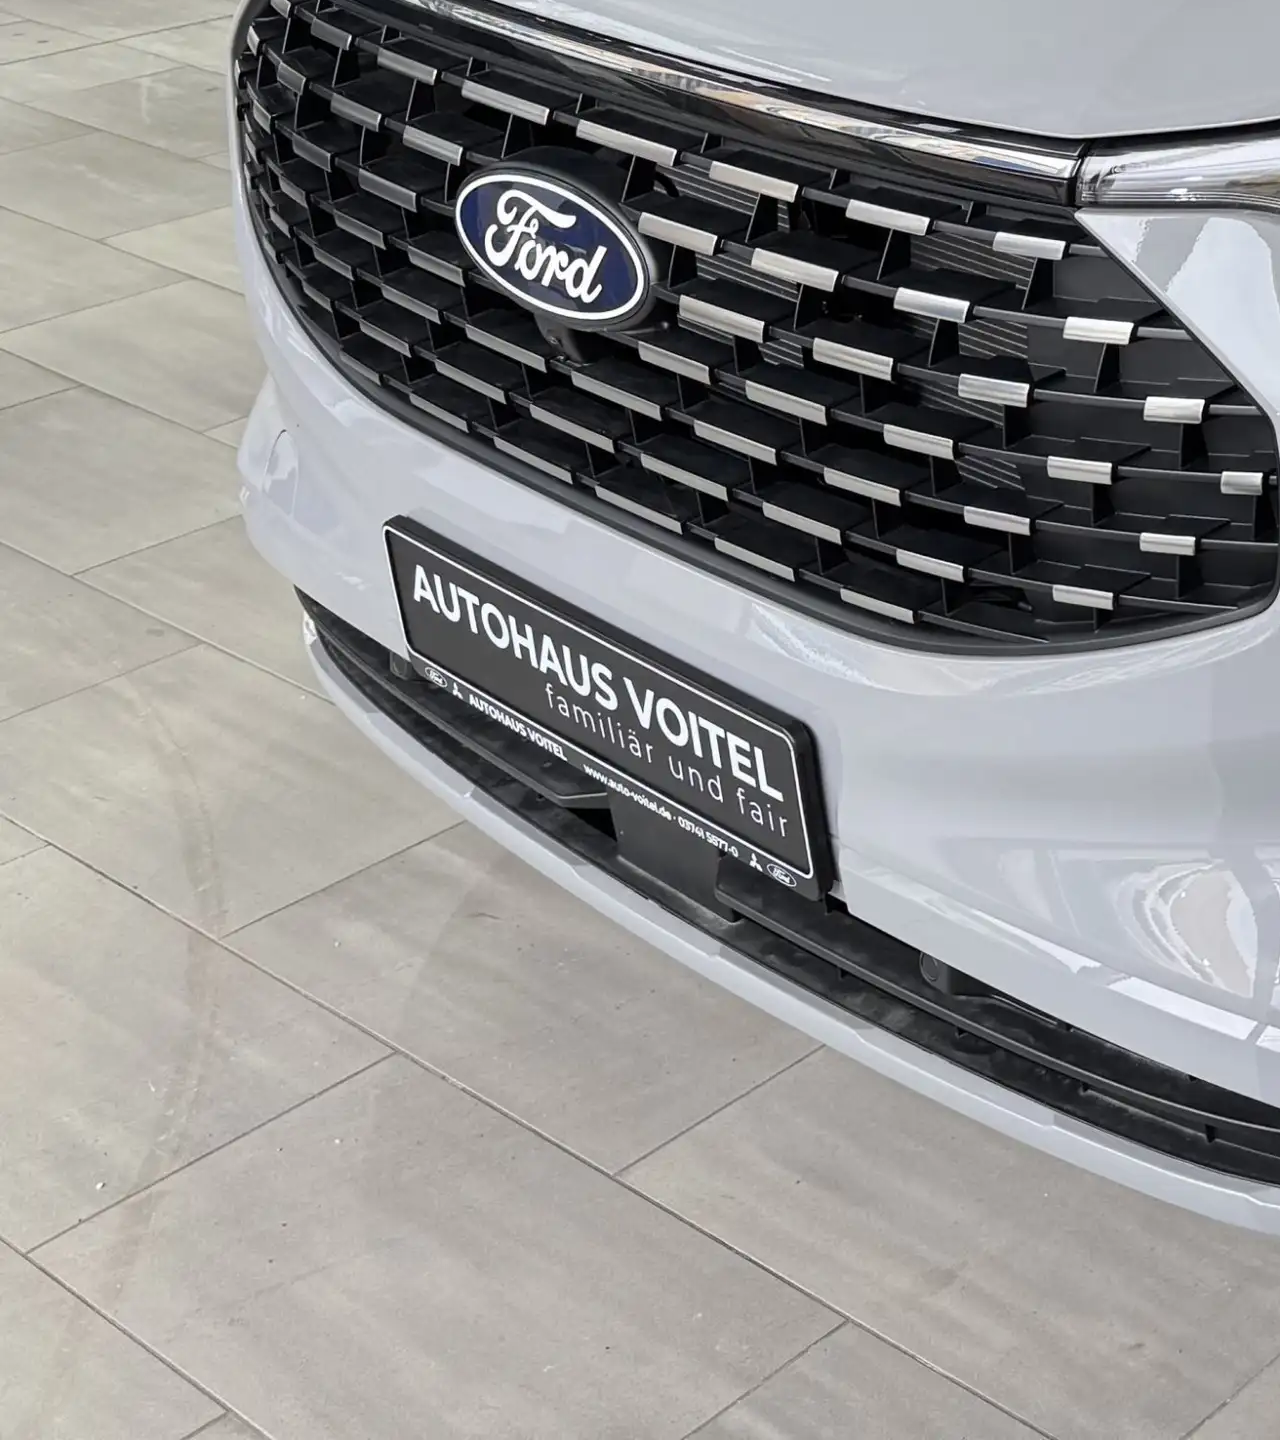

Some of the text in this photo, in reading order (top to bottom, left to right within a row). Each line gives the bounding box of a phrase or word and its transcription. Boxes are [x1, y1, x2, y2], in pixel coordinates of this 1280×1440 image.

[485, 189, 607, 304] Ford
[413, 564, 784, 802] AUTOHAUS VOITEL
[469, 694, 527, 737] AUTOHAUS
[526, 727, 568, 761] VOITEL
[582, 764, 672, 821] www.auto-voitel.de
[545, 682, 788, 837] familiär und fair
